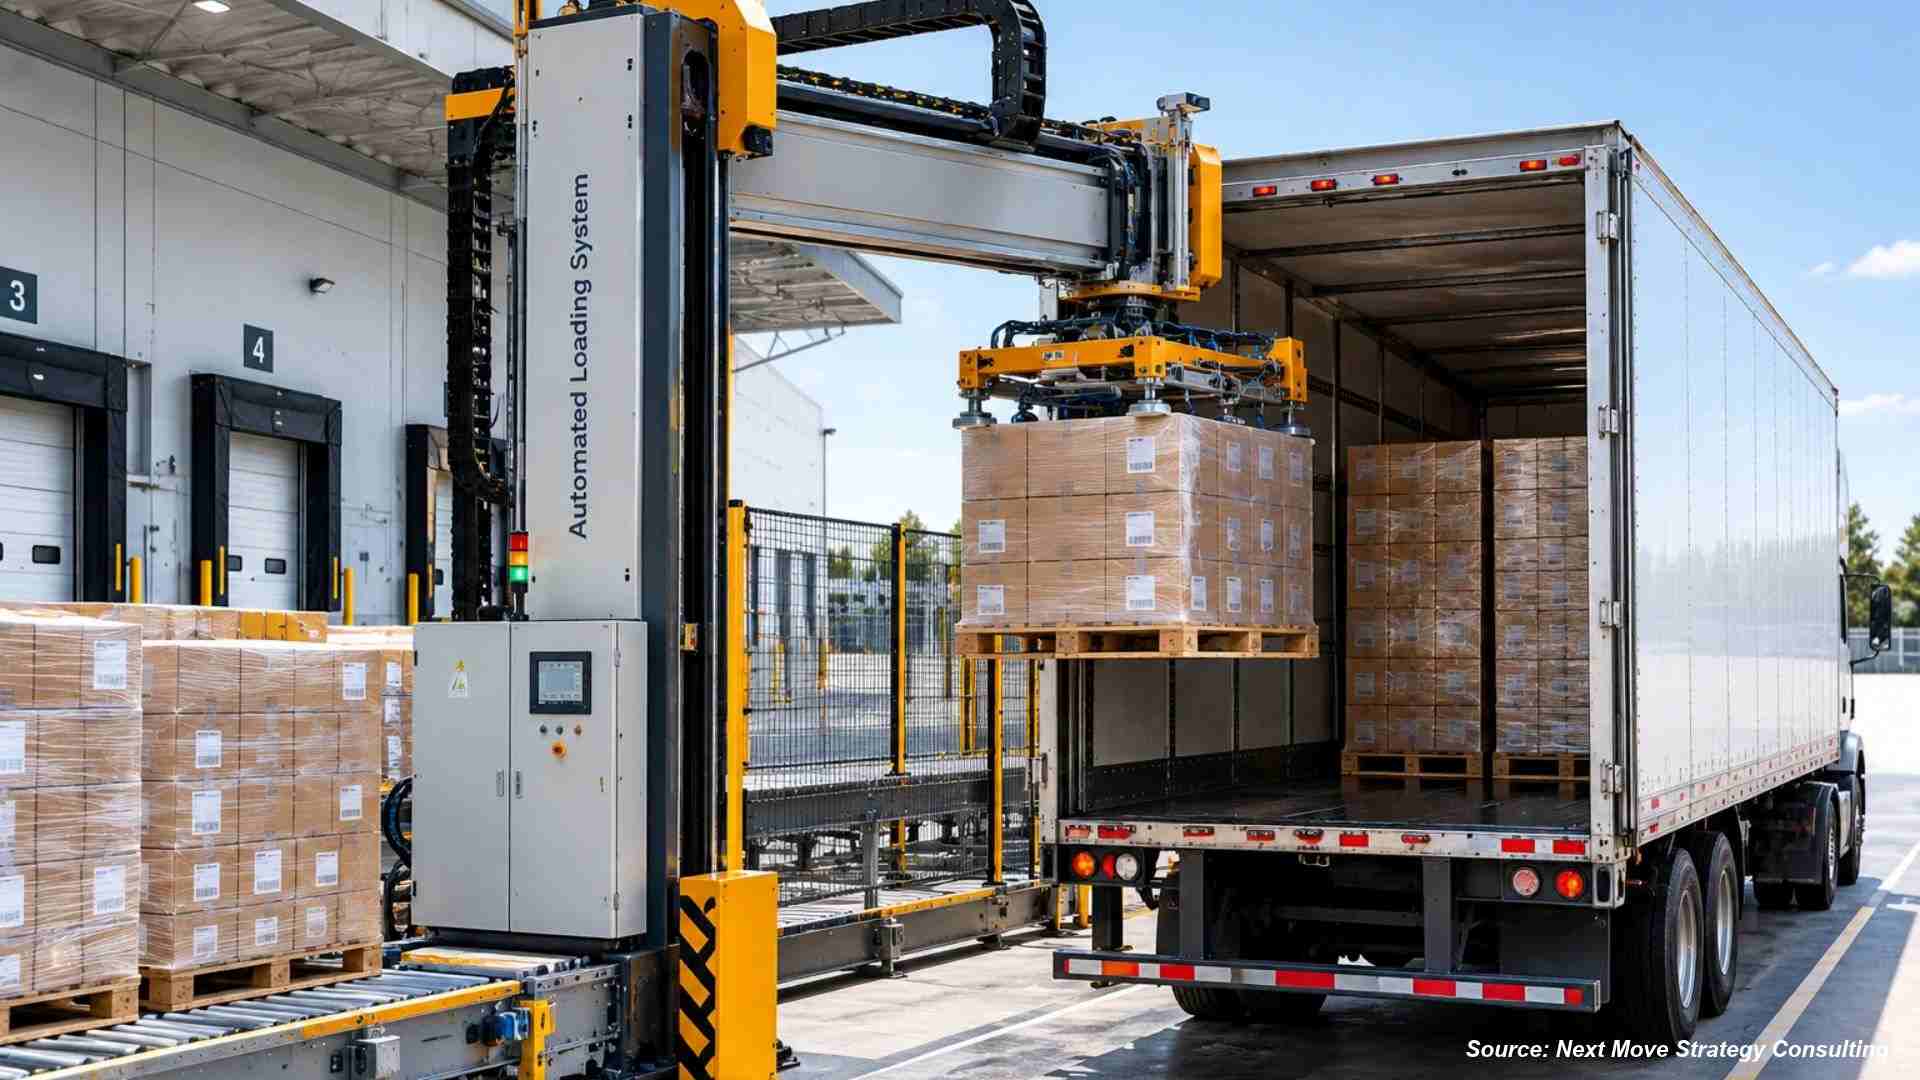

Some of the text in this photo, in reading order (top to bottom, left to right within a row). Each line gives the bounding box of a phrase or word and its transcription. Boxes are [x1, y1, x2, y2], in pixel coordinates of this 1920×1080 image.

[9, 280, 26, 311] 3
[252, 336, 266, 364] 4
[569, 173, 592, 540] Automated Loading System
